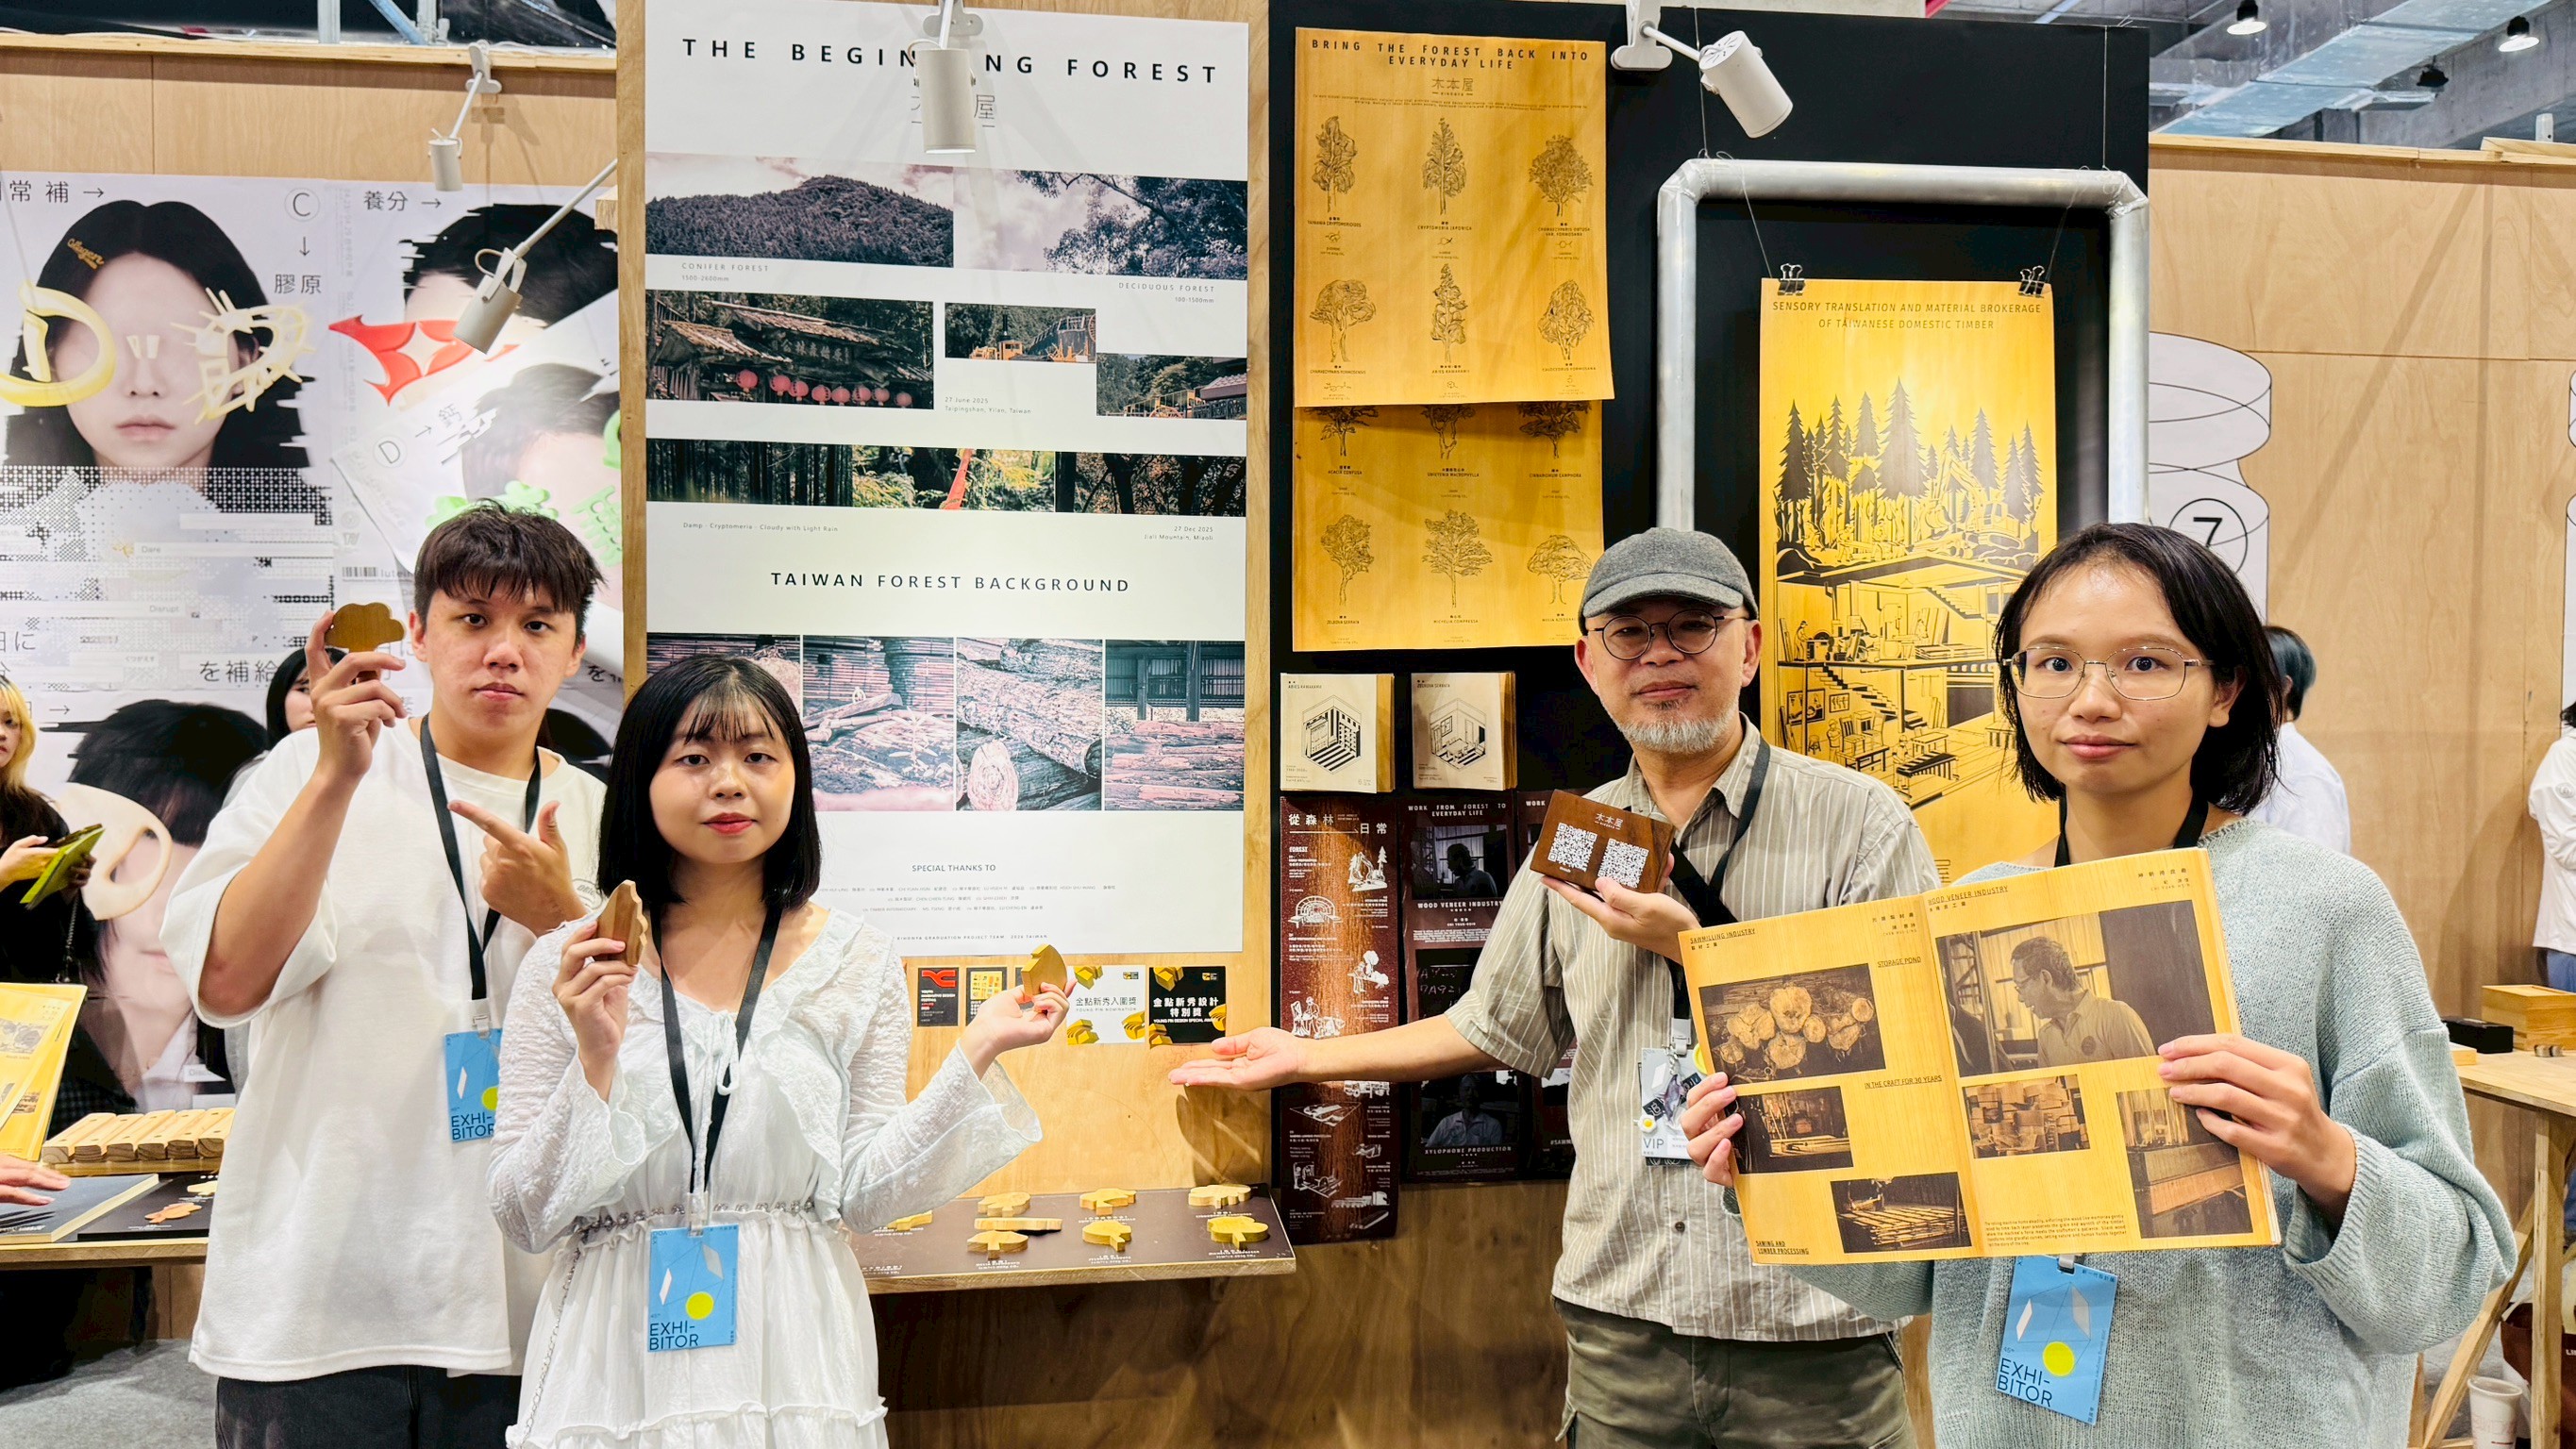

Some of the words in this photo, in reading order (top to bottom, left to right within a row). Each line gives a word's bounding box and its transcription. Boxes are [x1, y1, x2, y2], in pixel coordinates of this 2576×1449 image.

[1312, 39, 1361, 51] BRING
[1378, 42, 1405, 54] THE
[1422, 44, 1480, 57] FOREST
[1497, 48, 1536, 58] BACK
[1551, 51, 1588, 61] INTO
[682, 39, 756, 58] THE
[792, 43, 1032, 74] BEGINNG
[1067, 58, 1216, 83] FOREST
[1389, 56, 1468, 68] EVERYDAY
[1480, 59, 1513, 70] LIFE
[1431, 76, 1474, 92] 木本屋
[293, 192, 311, 217] C
[364, 191, 408, 211] 養分
[681, 262, 727, 271] CONIFER
[275, 274, 322, 294] 膠原
[1118, 282, 1175, 291] DECIDUOUS
[1772, 301, 1821, 312] SENSORY
[1825, 302, 1897, 312] TRANSLATION
[1899, 303, 1922, 312] AND
[1925, 303, 1976, 313] MATERIAL
[1980, 304, 2041, 313] BROKERAGE
[1818, 318, 1832, 328] OF
[1836, 318, 1895, 329] TAIWANESE
[1899, 319, 1951, 329] DOMESTIC
[1955, 320, 1994, 329] TIMBER
[2193, 516, 2223, 549] 7
[771, 572, 864, 587] TAIWAN
[878, 574, 962, 590] FOREST
[974, 576, 1129, 592] BACKGROUND
[1288, 813, 1334, 826] 從森林
[1360, 822, 1388, 835] 日常
[912, 864, 946, 873] SPECIAL
[948, 864, 983, 873] THANKS
[1947, 891, 1972, 902] VENEER
[1974, 885, 2009, 896] INDUSTRY
[1690, 932, 1726, 944] SAWMILLING
[1726, 927, 1756, 939] INDUSTRY
[1877, 958, 1904, 968] STORAGE
[1904, 956, 1922, 965] POND
[1075, 996, 1138, 1007] 金點新秀入圍獎
[1153, 996, 1219, 1008] 金點新秀設計
[1871, 1080, 1882, 1089] THE
[1883, 1078, 1900, 1087] CRAFT
[1923, 1074, 1943, 1083] YEARS
[451, 1111, 493, 1127] EXHI-
[1643, 1138, 1664, 1149] VIP
[1777, 1247, 1810, 1256] PROCESSING
[649, 1320, 695, 1337] EXHI-
[649, 1333, 699, 1351] BITOR
[1999, 1357, 2051, 1387] EXHI-
[1997, 1374, 2053, 1407] BITOR
